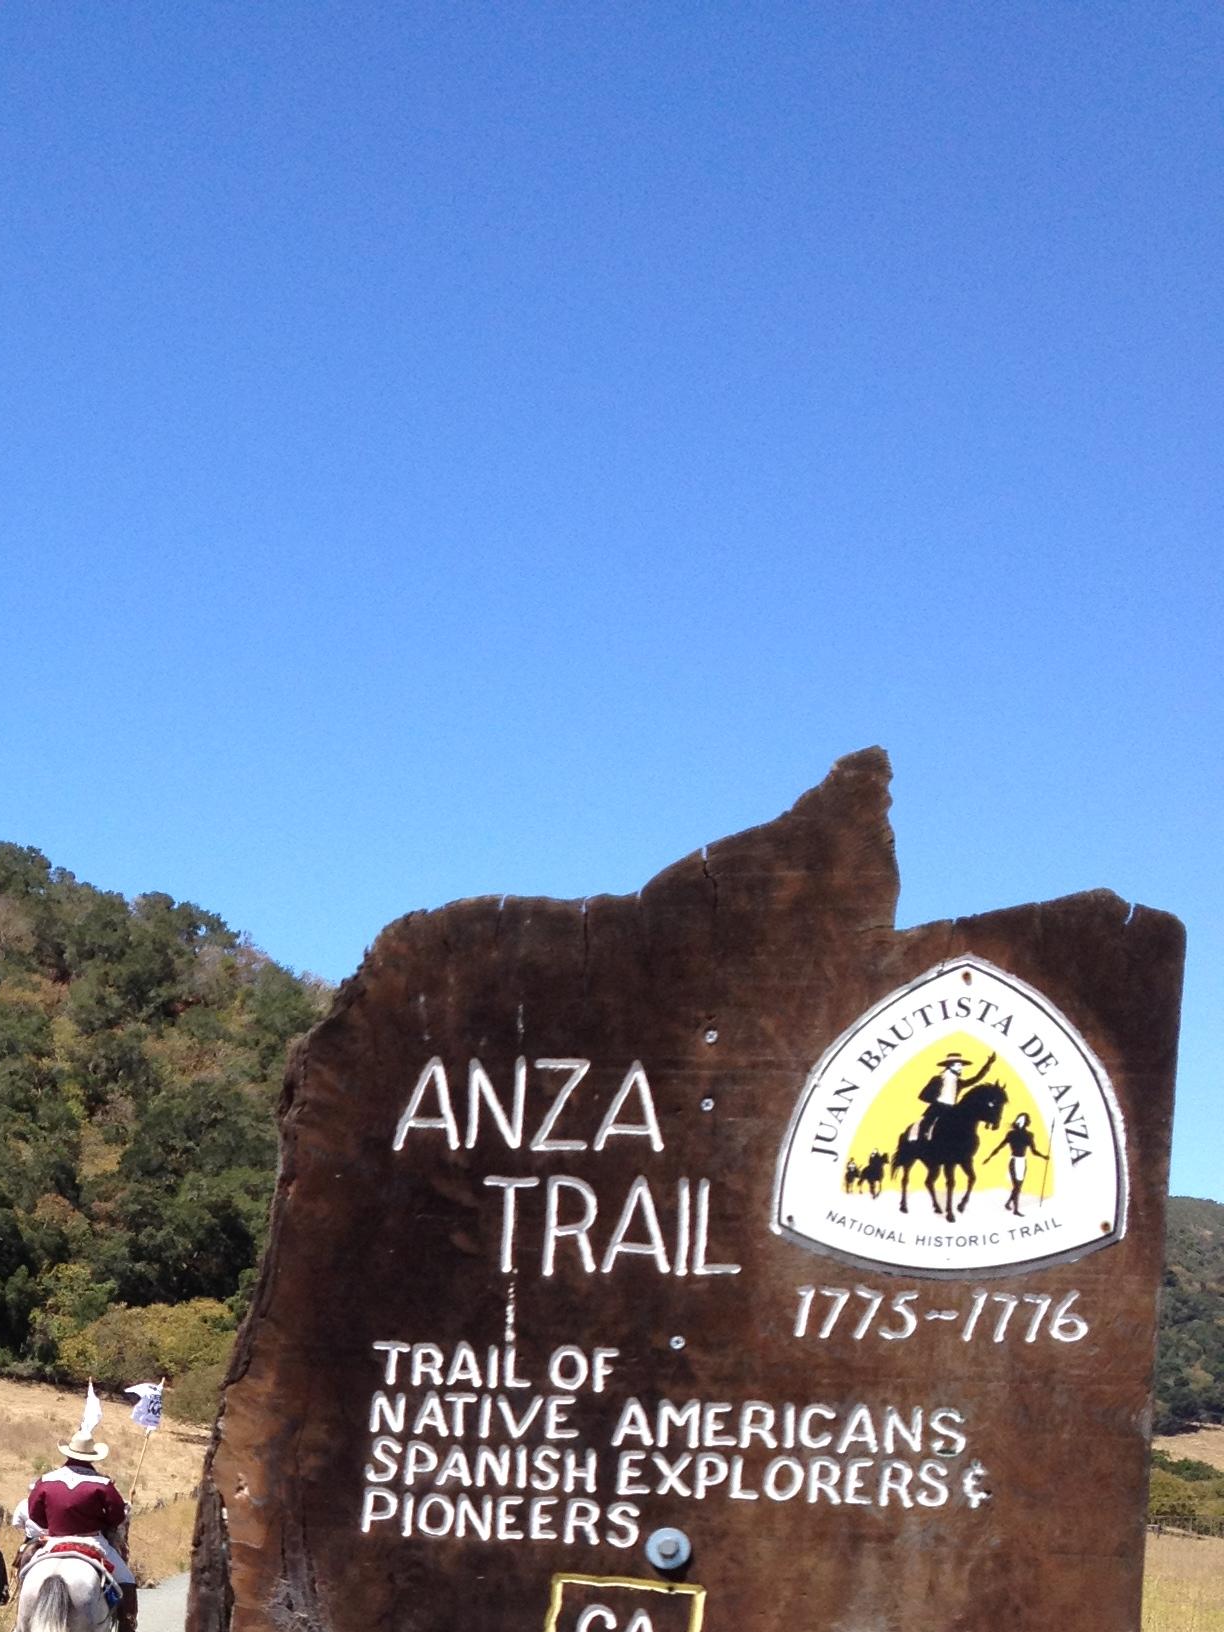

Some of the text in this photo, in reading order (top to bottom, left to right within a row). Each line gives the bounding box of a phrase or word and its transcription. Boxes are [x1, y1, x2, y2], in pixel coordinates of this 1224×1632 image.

[392, 1055, 664, 1151] ANZA
[811, 996, 1092, 1166] JUAN BAUTISTA DE ANZA
[484, 1174, 741, 1278] TRAIL
[825, 1209, 1062, 1248] NATIONAL HISTORIC TRAIL
[794, 1285, 1088, 1342] 1775-1776
[372, 1340, 619, 1393] TRAIL OF
[369, 1392, 966, 1457] NATIVE AMERICANS
[364, 1440, 598, 1494] SPANISH
[616, 1450, 949, 1509] EXPLORERS
[360, 1491, 640, 1548] PIONEERS
